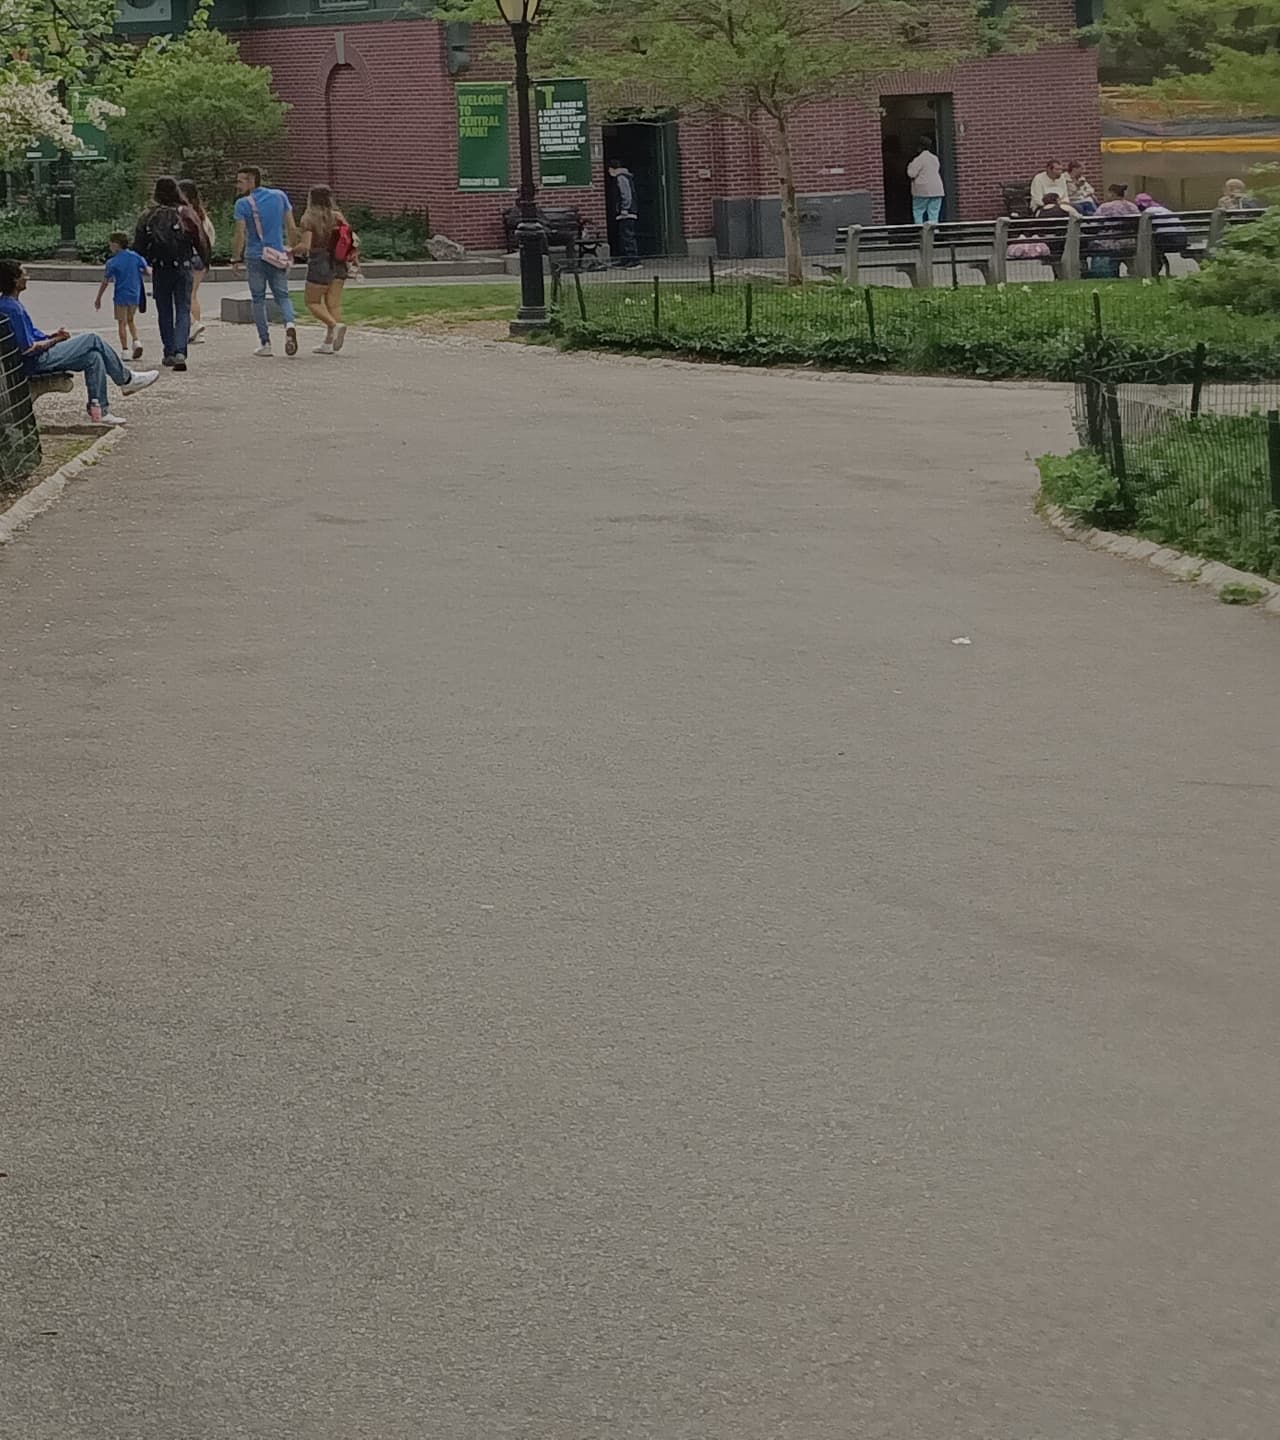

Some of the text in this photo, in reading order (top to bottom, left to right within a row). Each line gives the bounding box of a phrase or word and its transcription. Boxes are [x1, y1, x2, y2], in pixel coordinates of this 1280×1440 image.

[458, 95, 504, 105] WELCOME
[459, 106, 472, 115] TO
[459, 116, 500, 126] CENTRAL
[459, 127, 488, 137] PARK!
